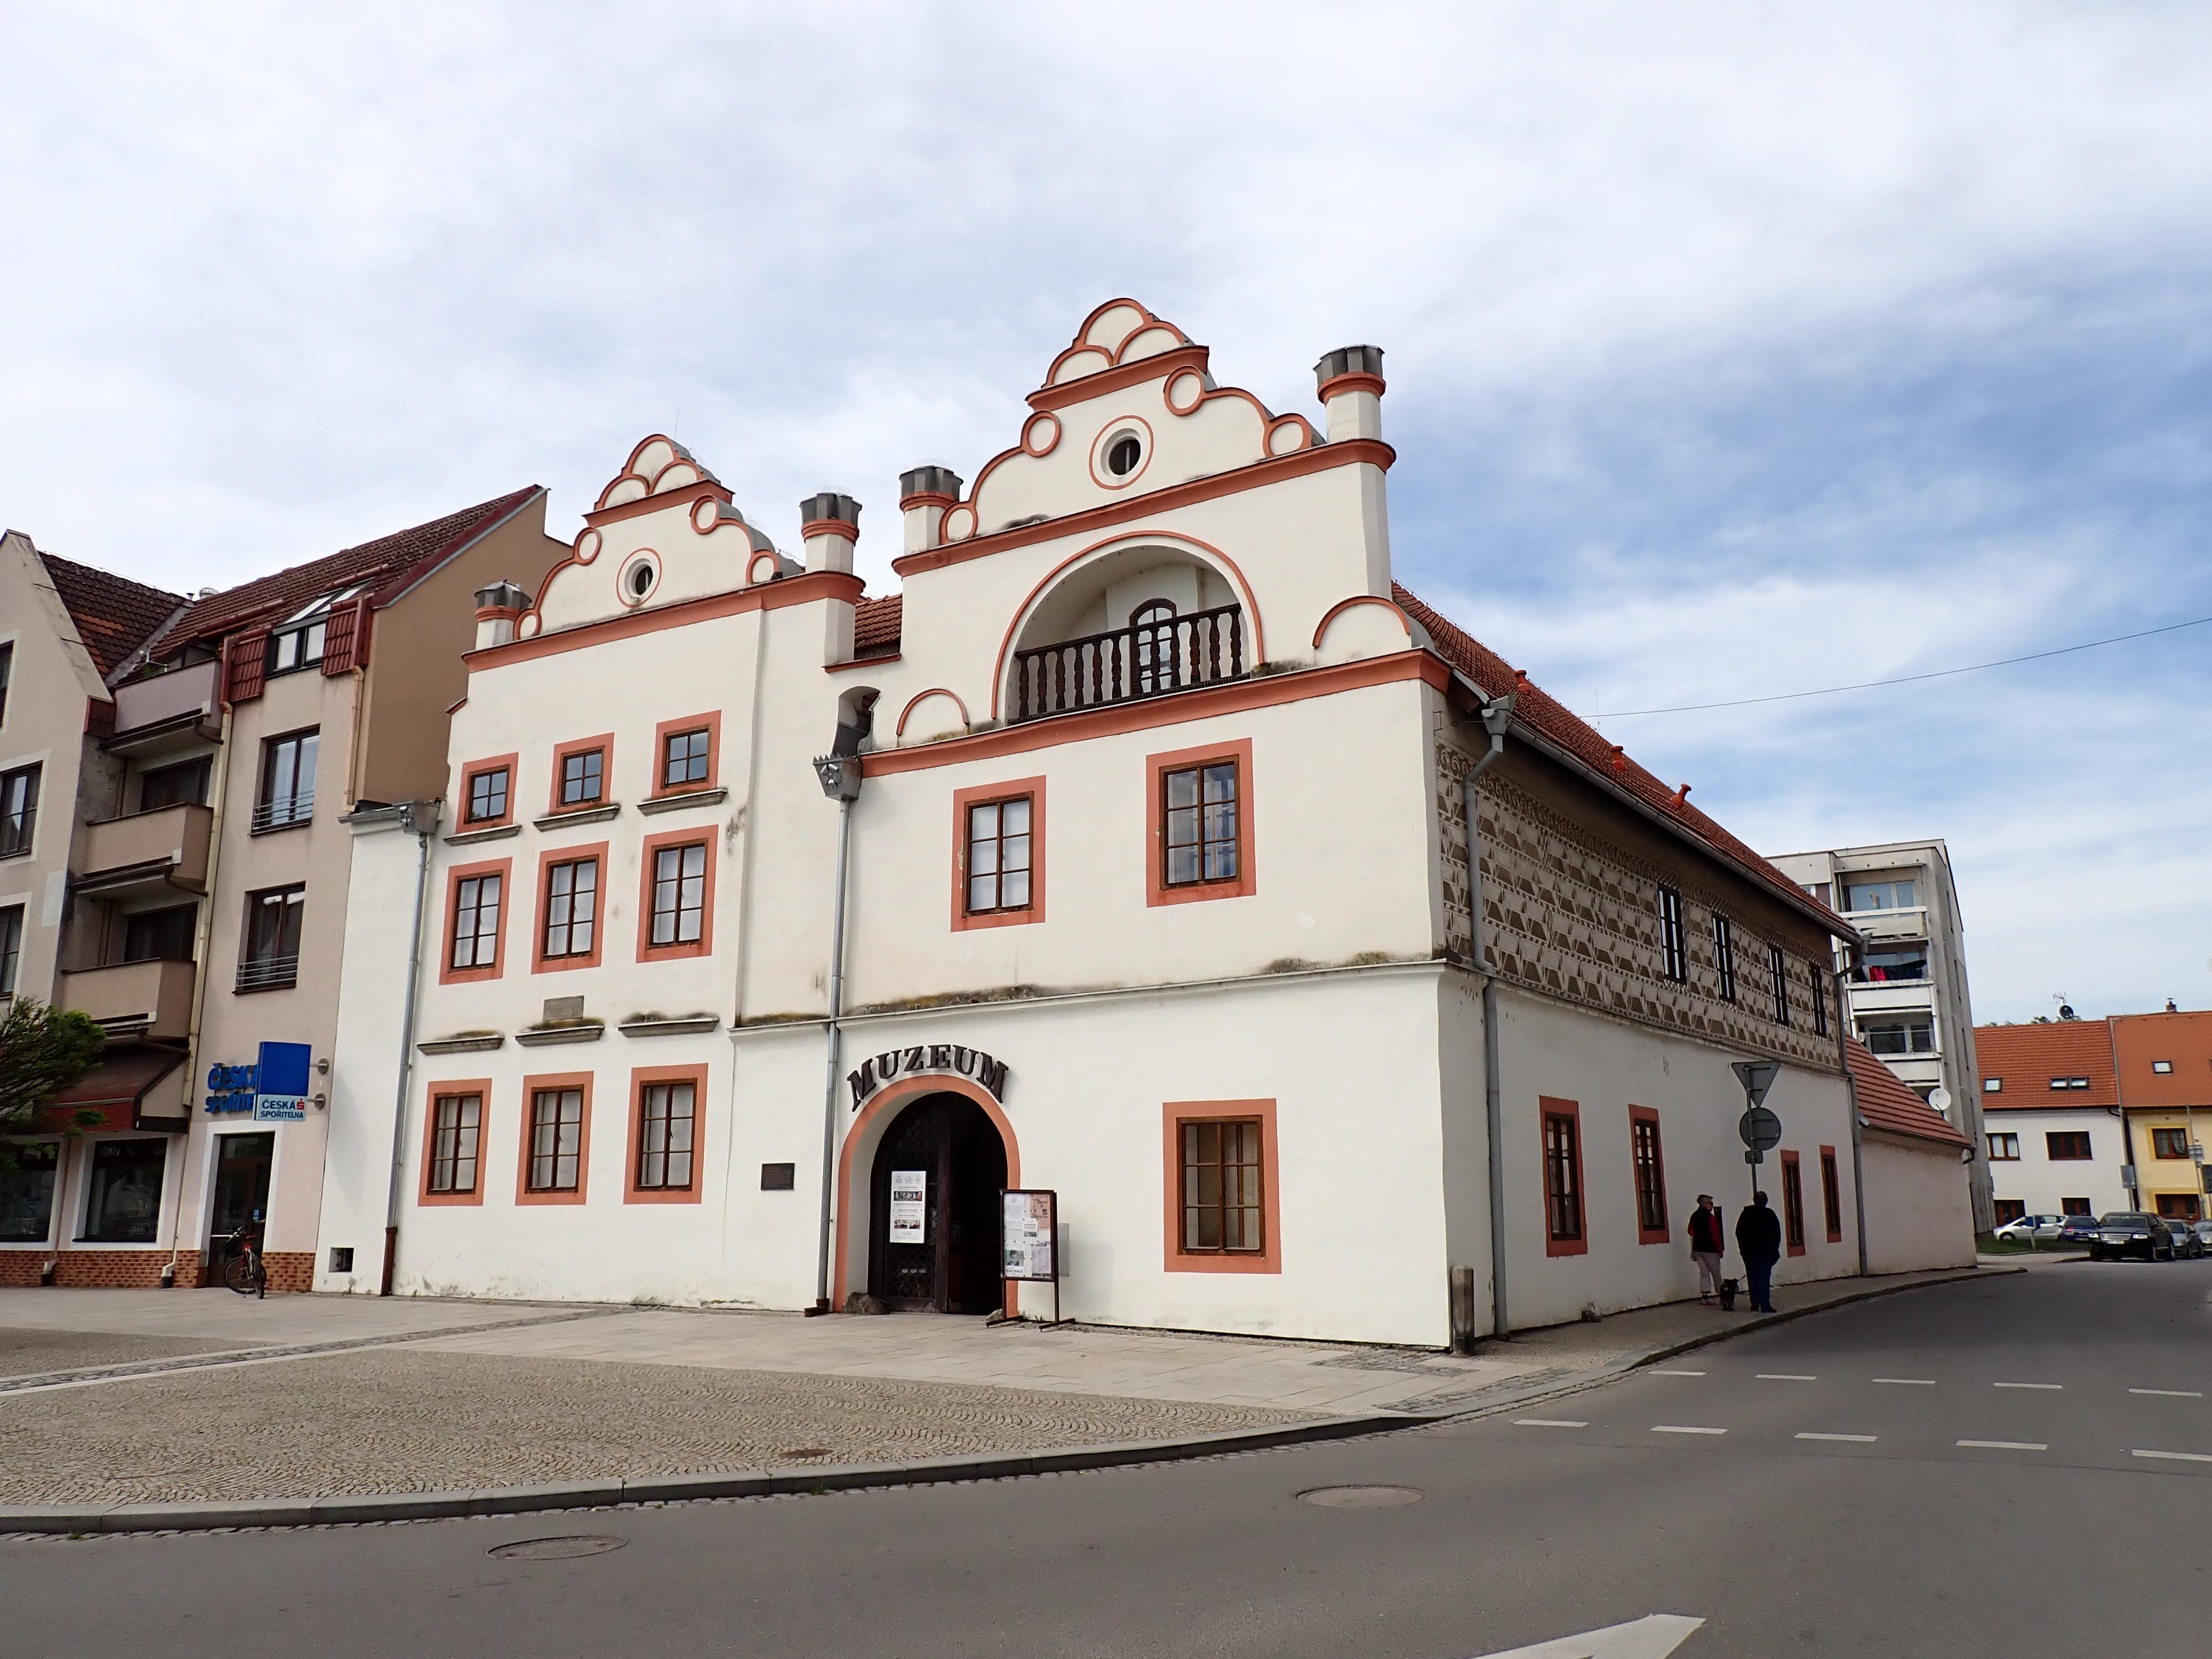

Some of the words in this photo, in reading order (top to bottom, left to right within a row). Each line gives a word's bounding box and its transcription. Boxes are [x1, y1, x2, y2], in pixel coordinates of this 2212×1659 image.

[847, 1044, 1009, 1112] MUZEUM
[262, 1098, 295, 1110] ČESKÁ
[260, 1110, 304, 1118] SPOŘITELNA
